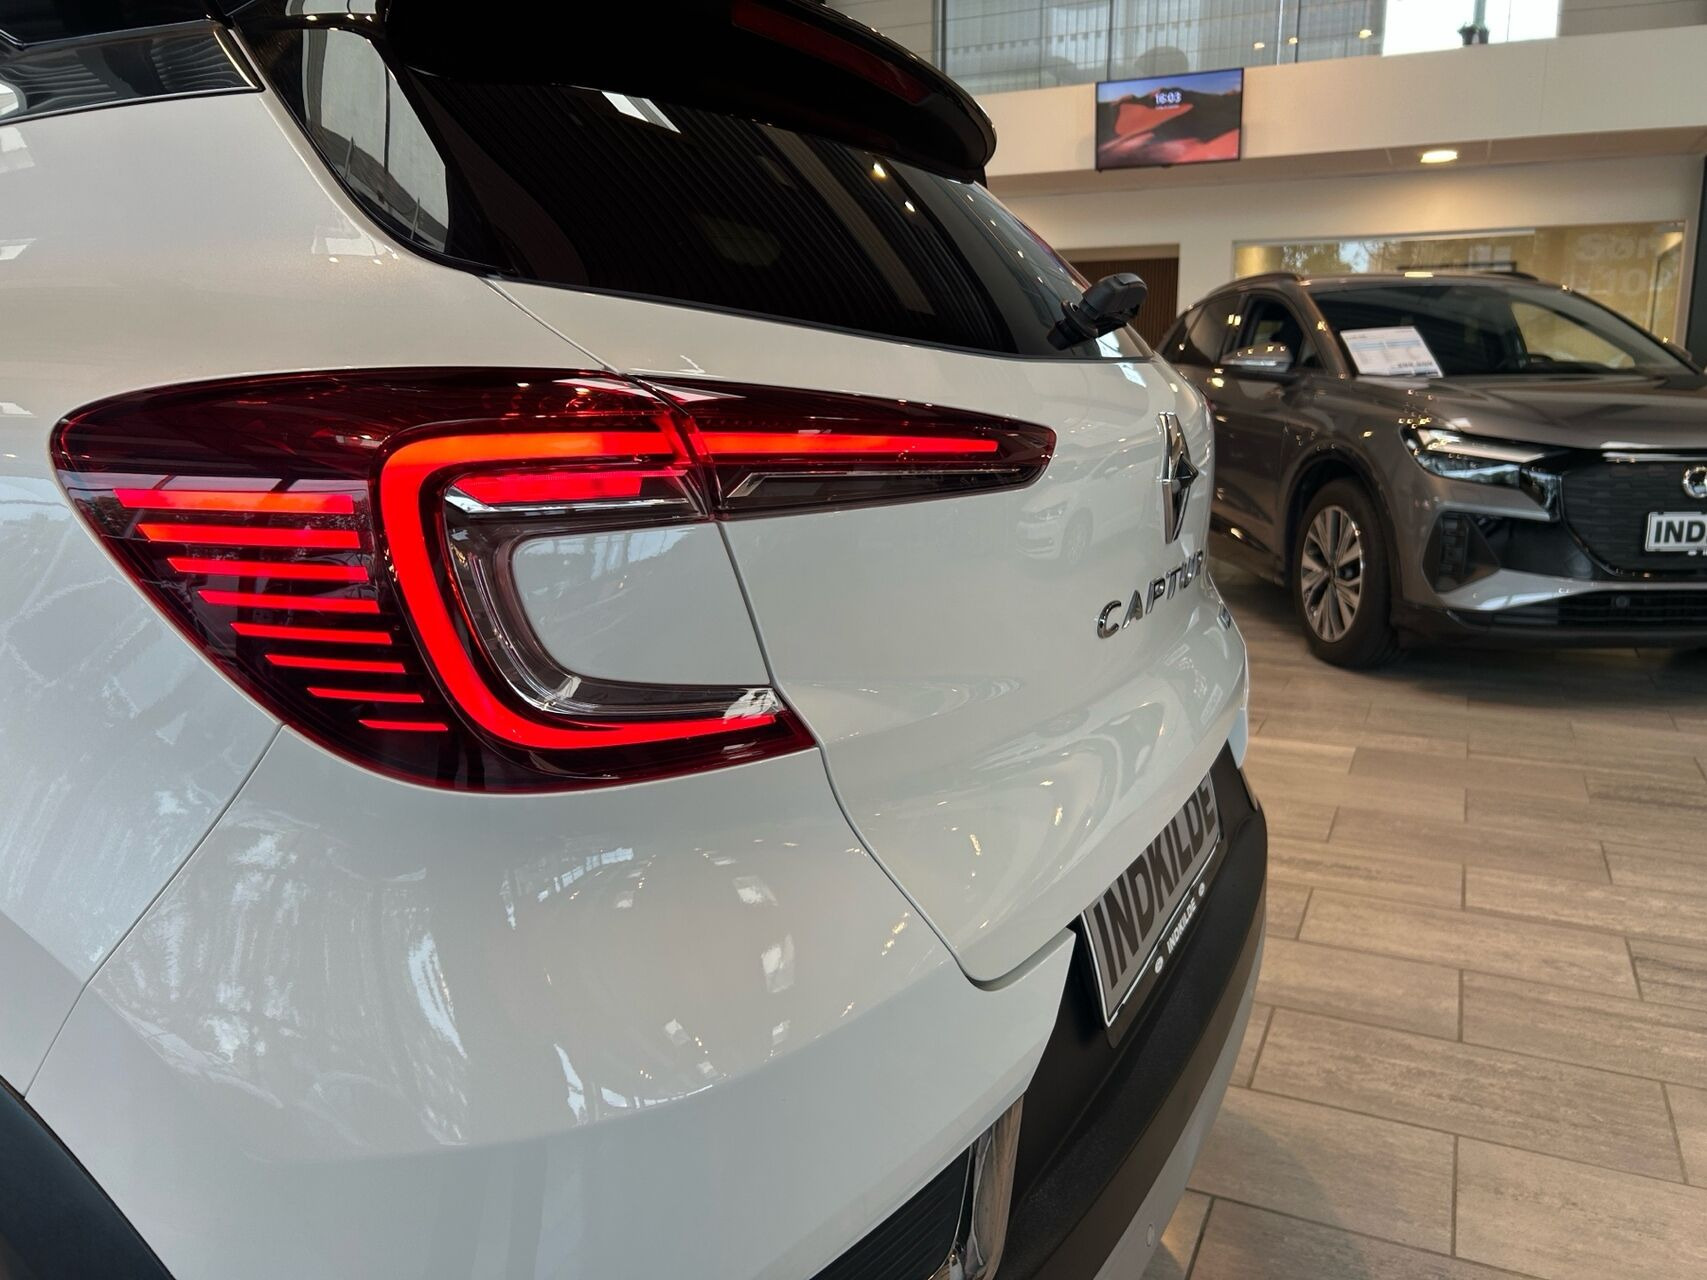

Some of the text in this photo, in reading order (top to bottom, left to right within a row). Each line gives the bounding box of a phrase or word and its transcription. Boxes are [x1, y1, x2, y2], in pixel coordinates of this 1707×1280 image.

[1654, 520, 1707, 544] IND
[1097, 550, 1203, 640] CAPTUR
[1094, 784, 1216, 990] INDKILDE
[1166, 897, 1198, 955] INDKILDE
